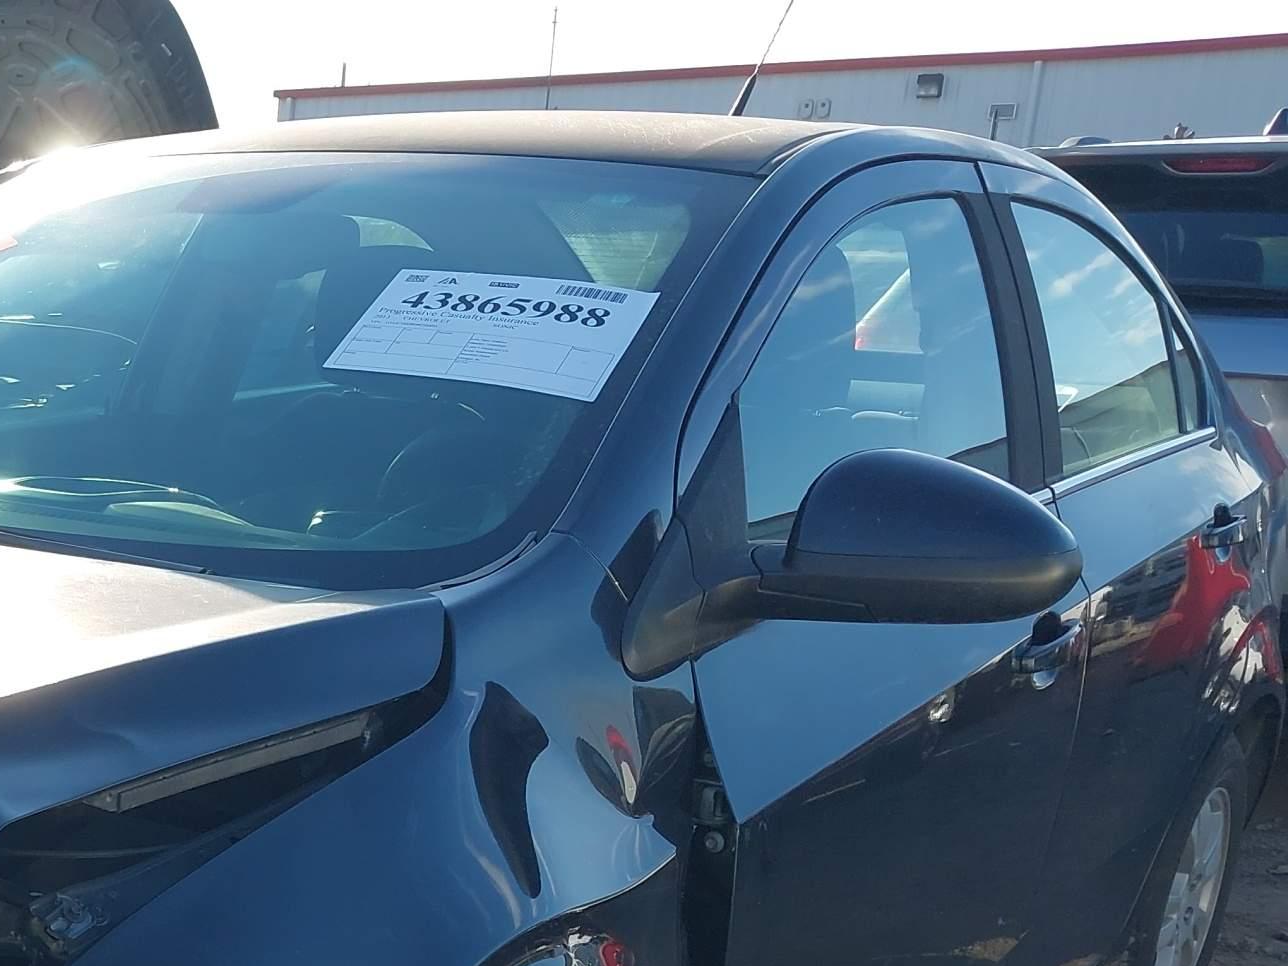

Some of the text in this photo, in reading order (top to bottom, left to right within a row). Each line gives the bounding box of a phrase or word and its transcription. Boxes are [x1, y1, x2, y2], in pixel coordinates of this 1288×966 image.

[378, 307, 540, 326] Progressive Casualty Insurance
[401, 291, 611, 328] 43865988
